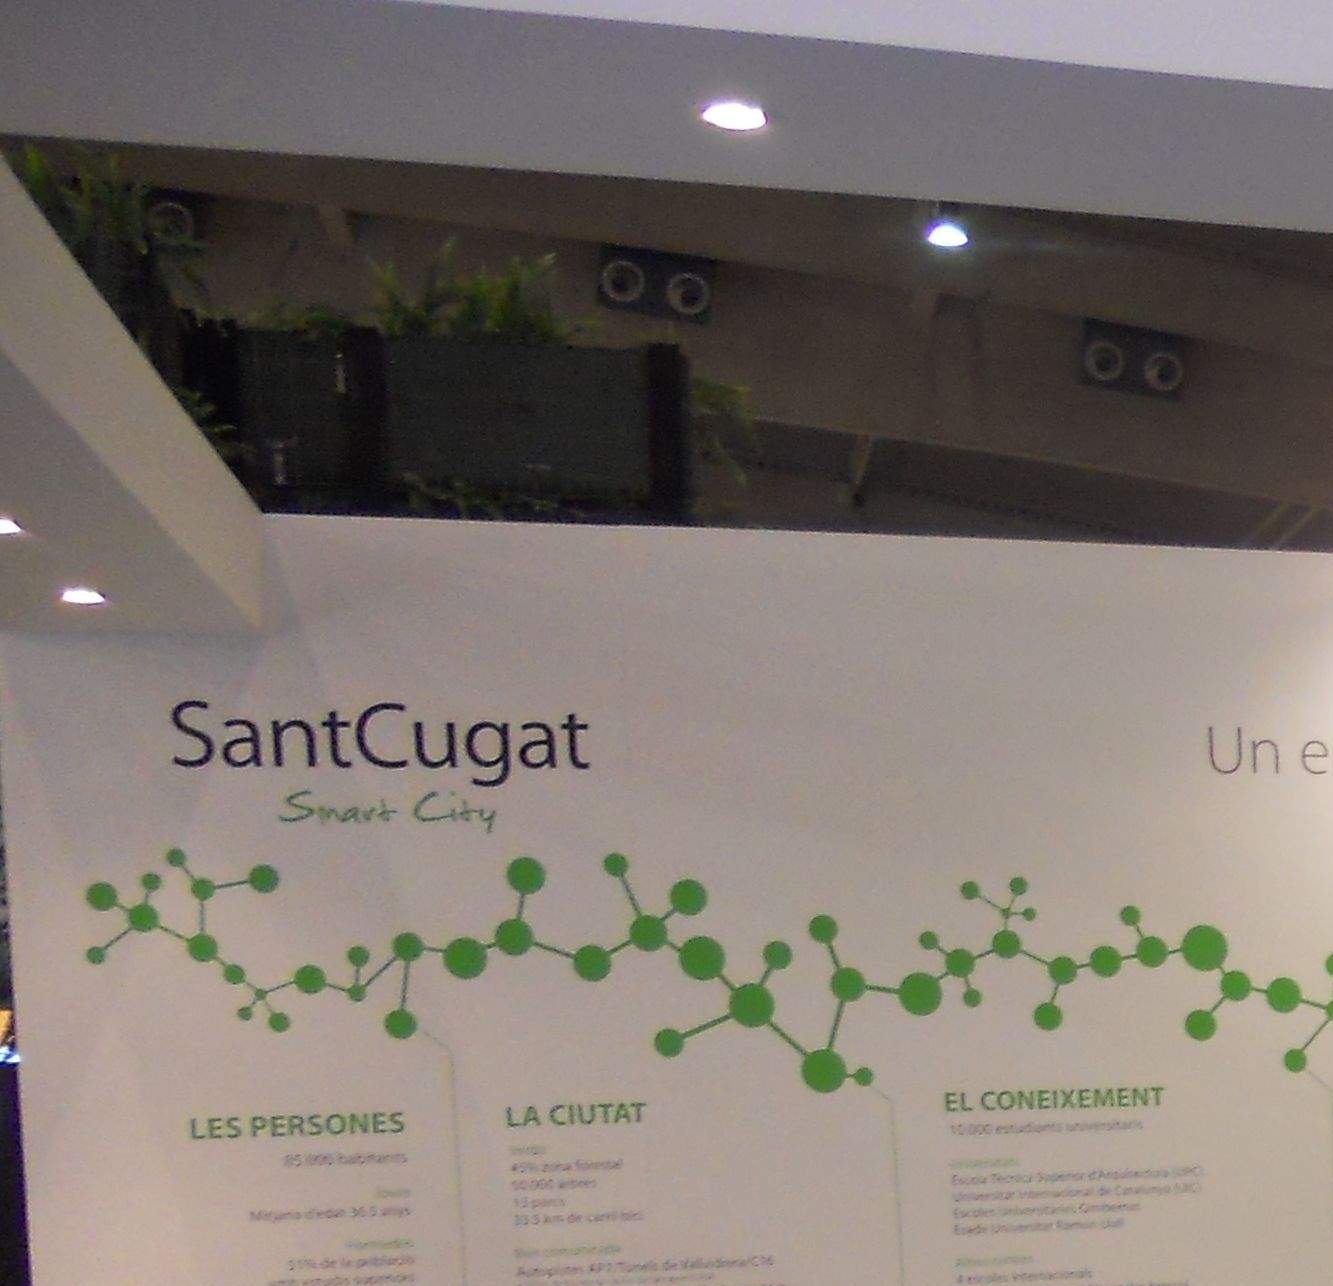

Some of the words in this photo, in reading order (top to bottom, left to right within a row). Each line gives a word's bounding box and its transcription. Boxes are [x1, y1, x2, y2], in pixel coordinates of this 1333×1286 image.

[171, 700, 591, 787] SantCugat
[1207, 726, 1279, 776] Un
[279, 790, 398, 825] Smart
[412, 792, 498, 832] City
[505, 1106, 540, 1128] LA
[550, 1102, 646, 1125] CIUTAT
[944, 1091, 974, 1112] EL
[980, 1087, 1164, 1111] CONEIXEMENT
[190, 1116, 242, 1139] LES
[251, 1112, 405, 1137] PERSONES
